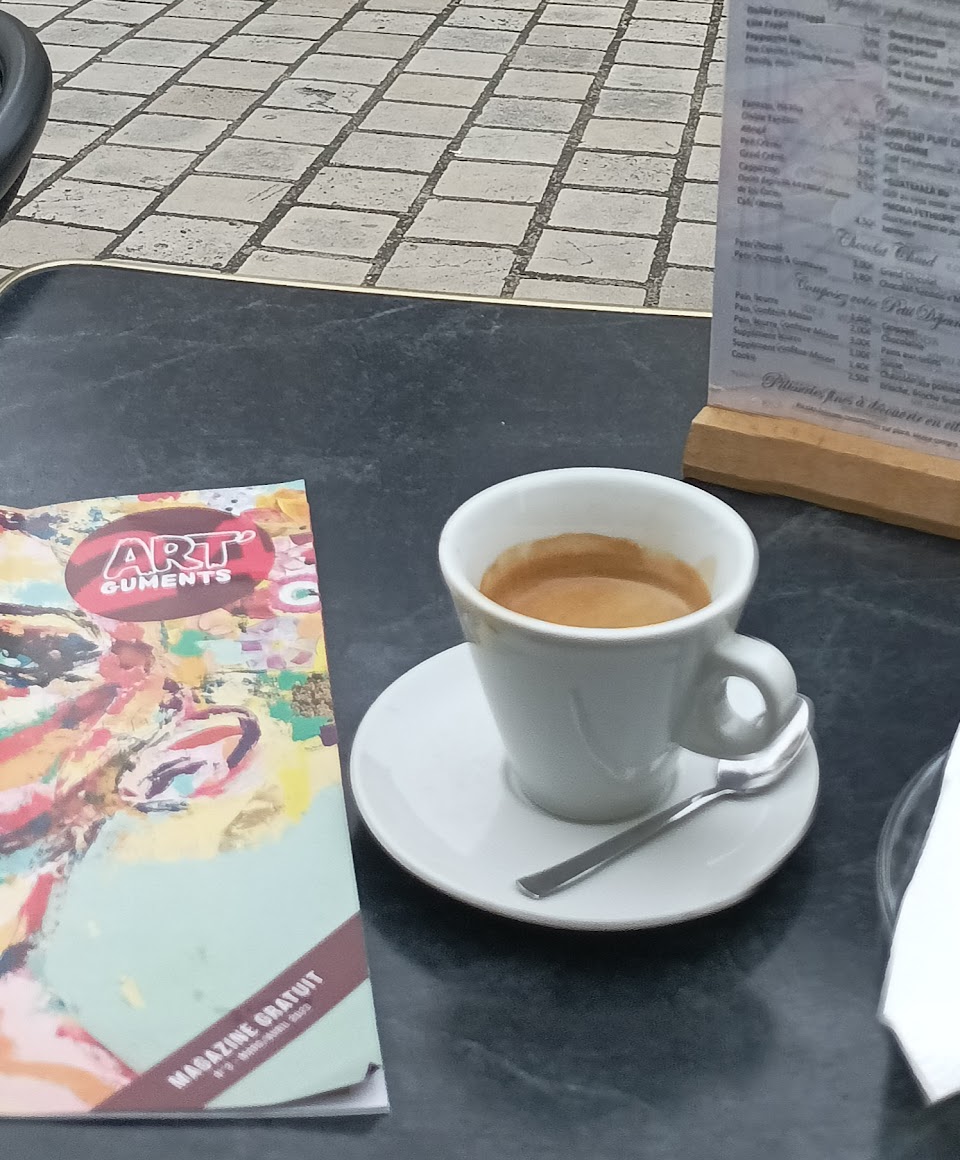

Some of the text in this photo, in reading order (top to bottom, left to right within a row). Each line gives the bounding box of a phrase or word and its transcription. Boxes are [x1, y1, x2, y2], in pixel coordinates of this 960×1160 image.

[100, 569, 232, 595] GUMENTS
[167, 1021, 259, 1090] MAGAZINE
[253, 969, 324, 1028] GRATUIT
